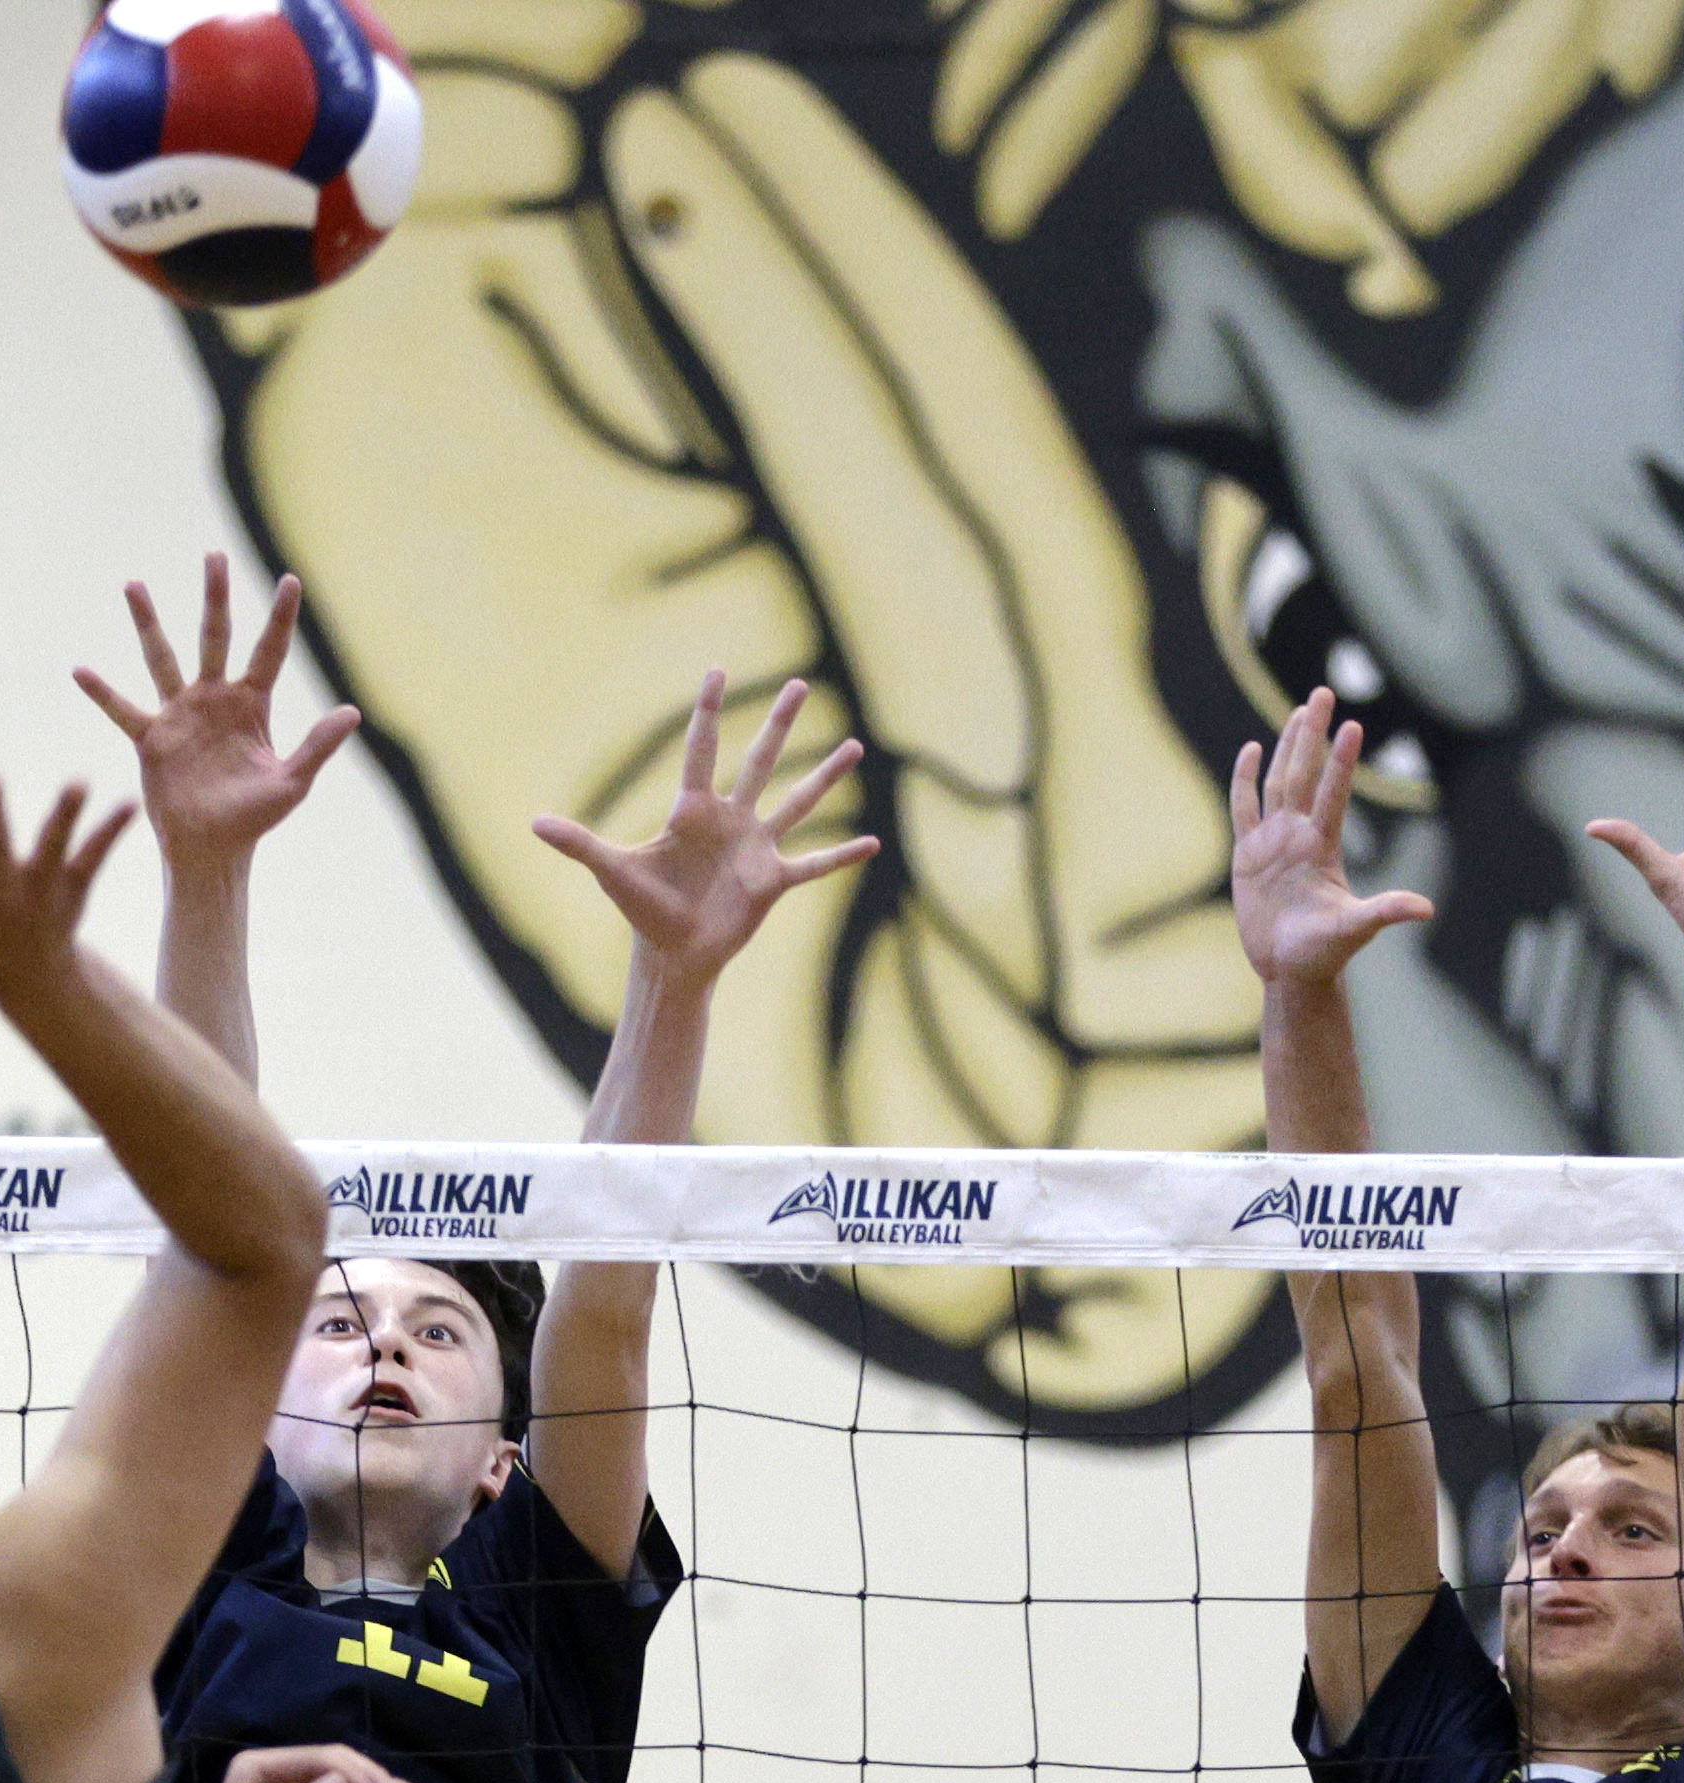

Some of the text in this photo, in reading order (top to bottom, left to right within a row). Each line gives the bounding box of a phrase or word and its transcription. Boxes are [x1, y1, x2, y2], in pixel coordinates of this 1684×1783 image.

[371, 1217, 498, 1239] VOLLEYBALL
[836, 1223, 962, 1244] VOLLEYBALL
[1300, 1228, 1426, 1250] VOLLEYBALL
